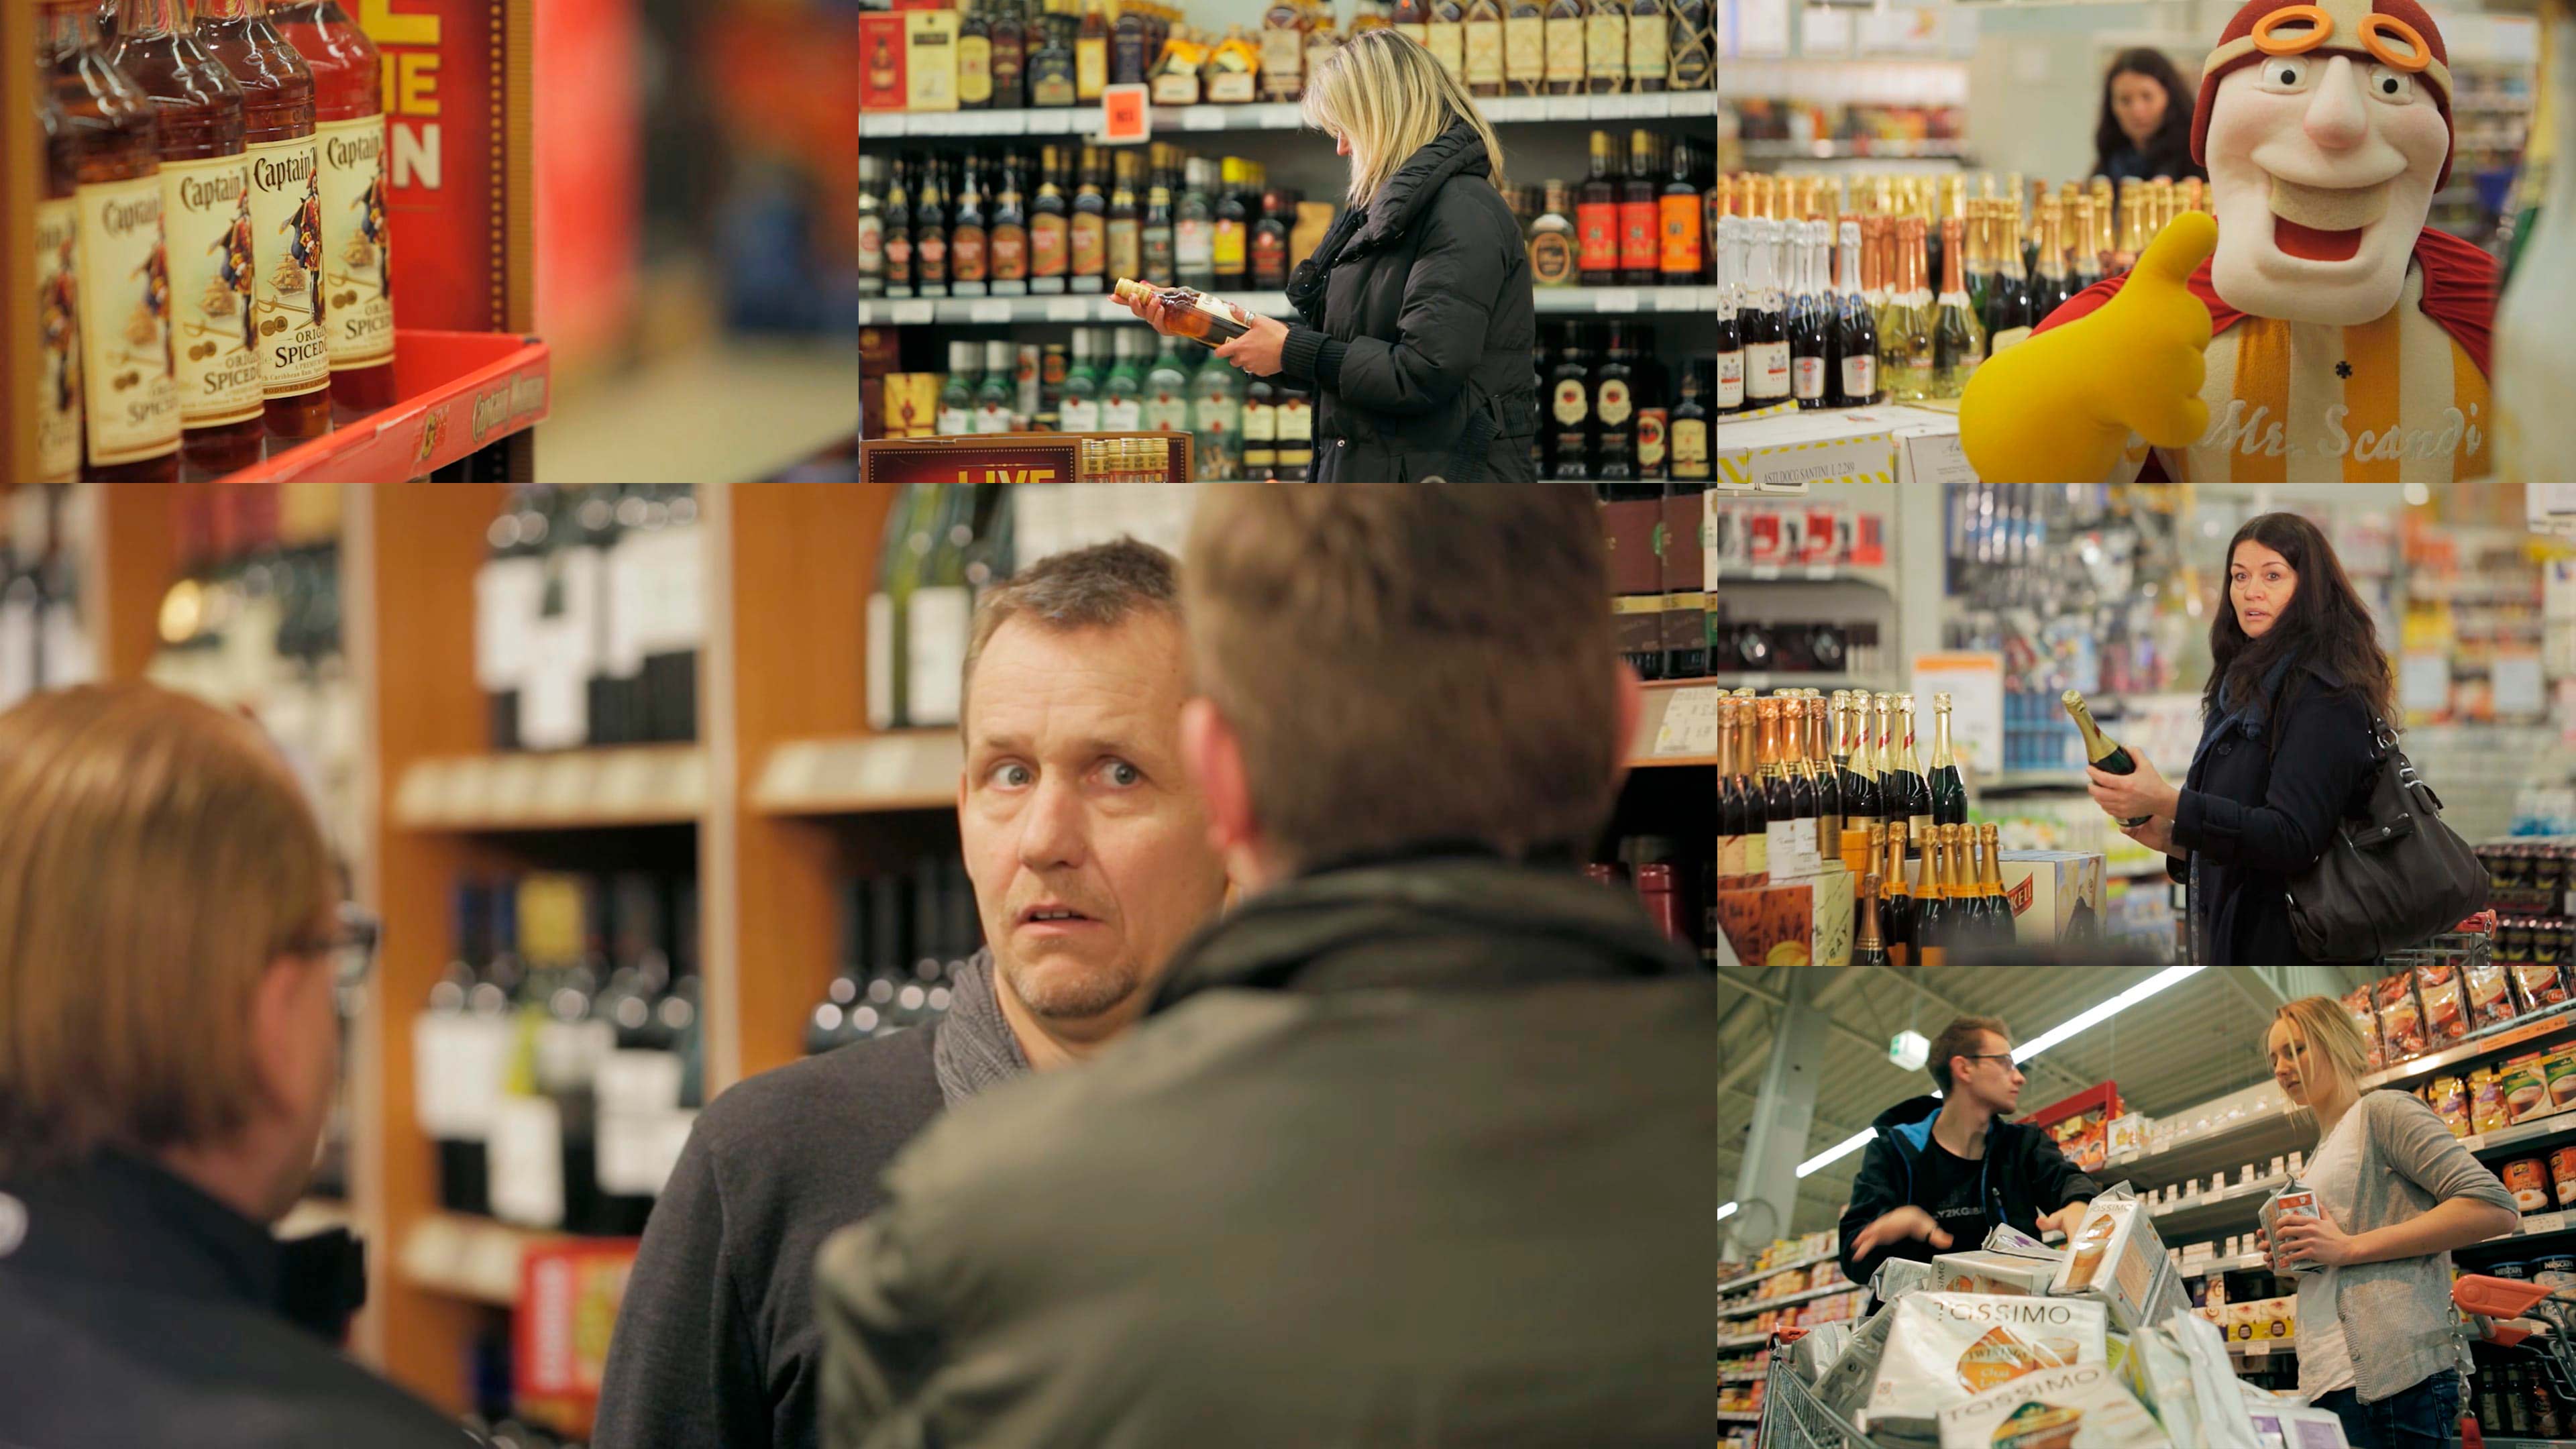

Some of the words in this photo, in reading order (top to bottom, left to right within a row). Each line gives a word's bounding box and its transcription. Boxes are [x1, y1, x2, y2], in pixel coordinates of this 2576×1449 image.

[327, 132, 379, 170] Captain
[254, 150, 317, 193] Captain
[181, 170, 240, 213] Captain
[275, 340, 323, 368] SPICED
[2201, 398, 2306, 457] Mr.
[2318, 402, 2481, 462] Scandi
[2010, 881, 2032, 909] KELL
[1937, 1261, 1945, 1290] SIMO
